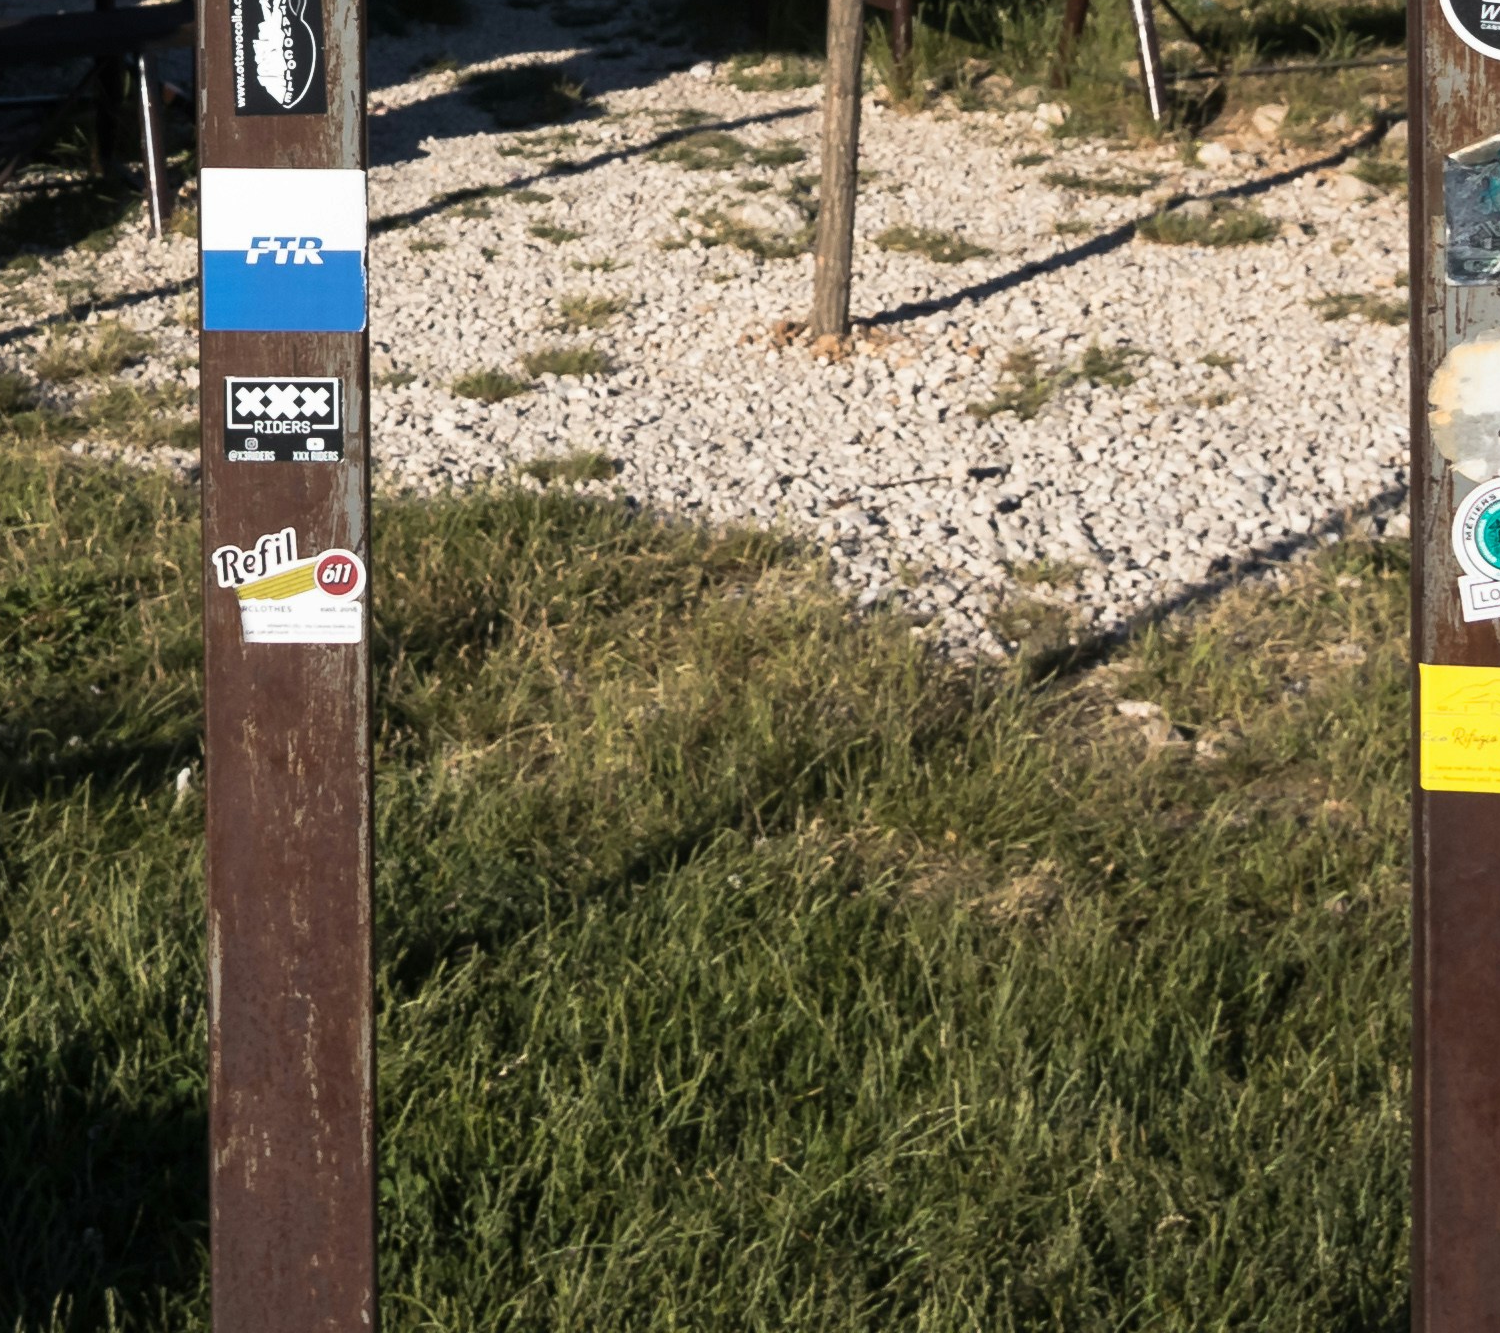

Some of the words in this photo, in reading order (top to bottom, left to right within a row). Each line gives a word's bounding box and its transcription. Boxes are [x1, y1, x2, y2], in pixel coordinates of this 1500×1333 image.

[245, 236, 325, 265] FTR
[254, 420, 311, 434] RIDERS
[310, 449, 339, 462] RIDERS
[1465, 492, 1497, 541] MÉTIERS
[217, 532, 292, 584] Refil
[322, 563, 352, 584] 611
